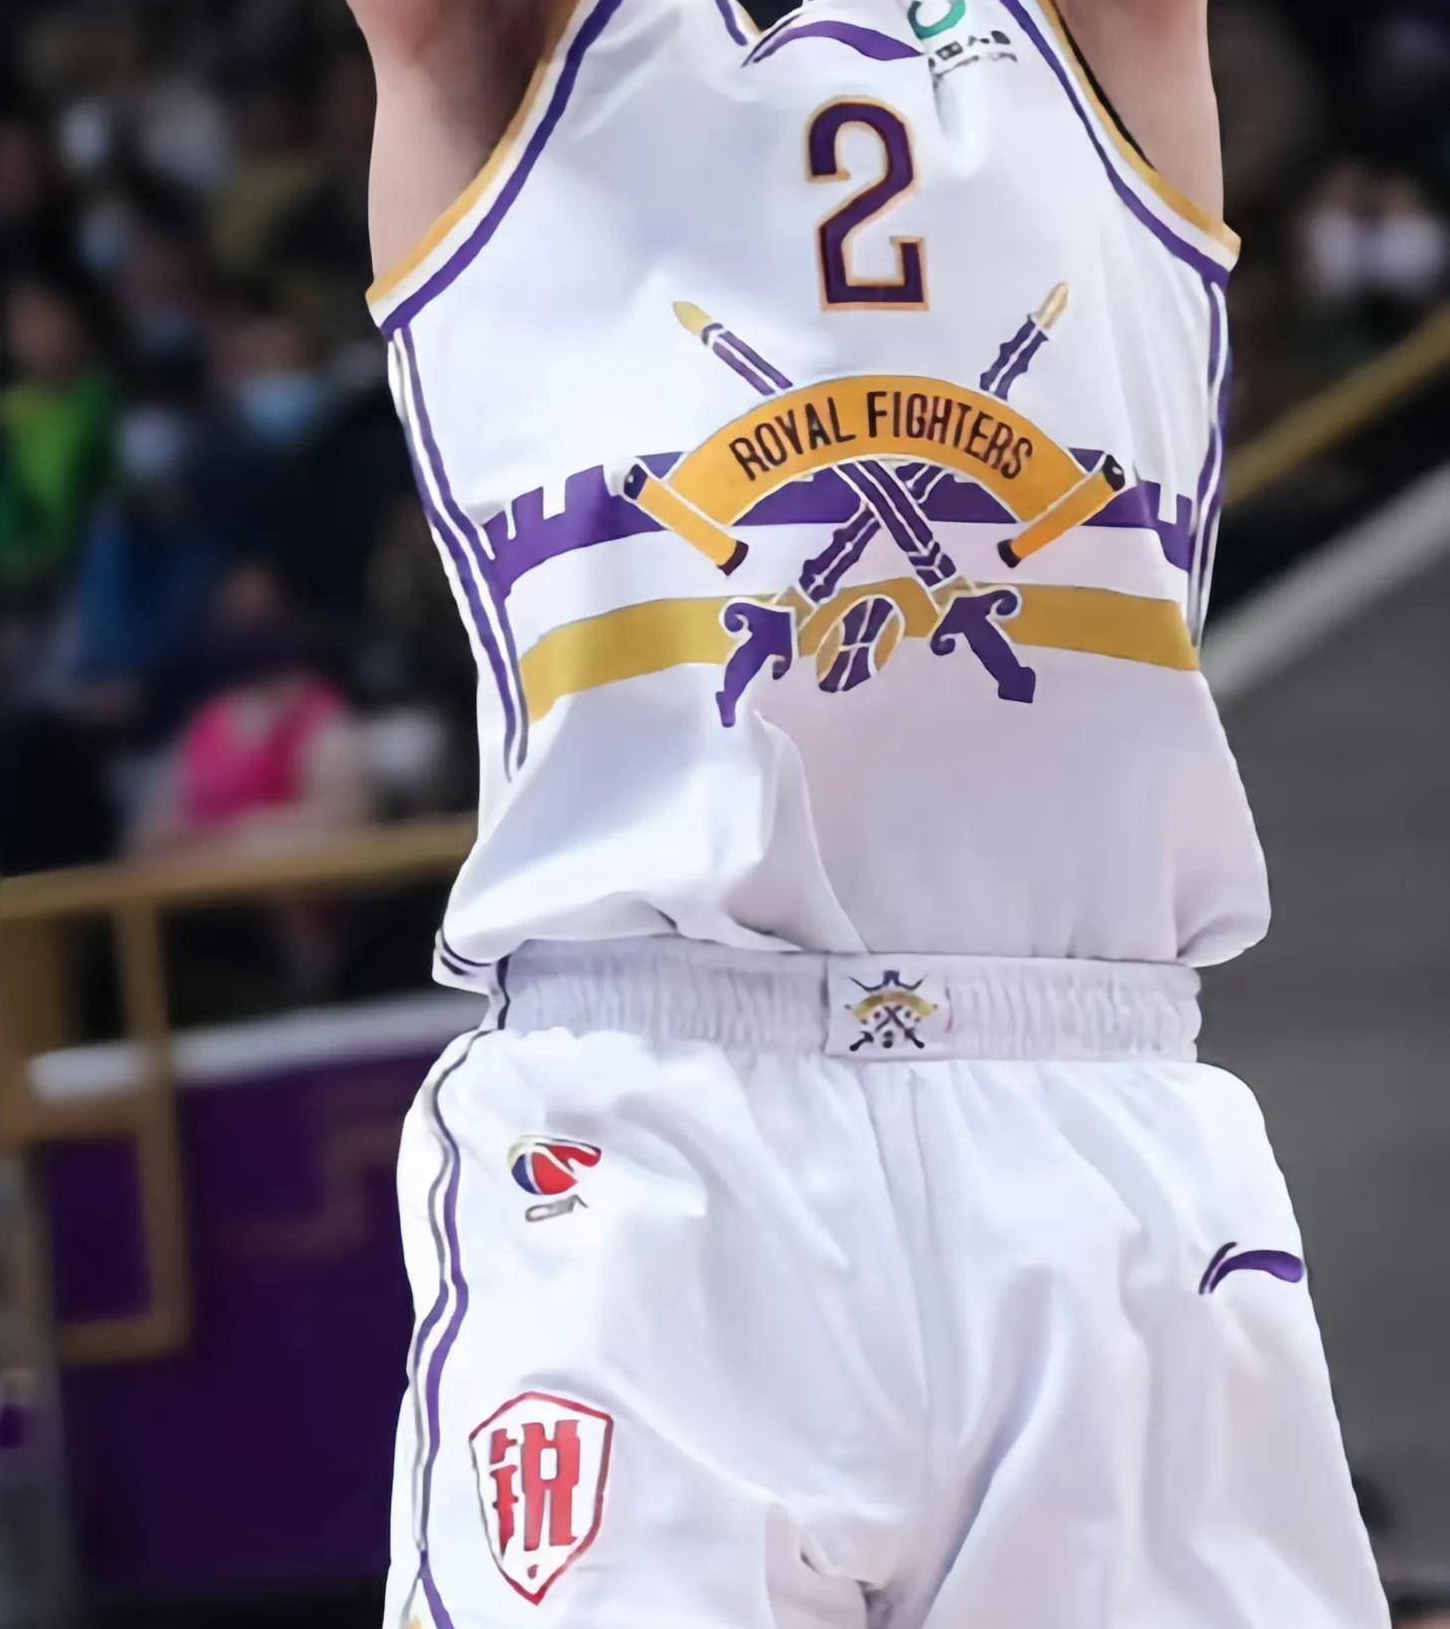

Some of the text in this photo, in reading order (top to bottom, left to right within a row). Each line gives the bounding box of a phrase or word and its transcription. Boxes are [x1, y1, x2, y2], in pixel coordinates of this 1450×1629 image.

[805, 95, 929, 311] 2
[728, 390, 1034, 482] ROYAL FIGHTERS
